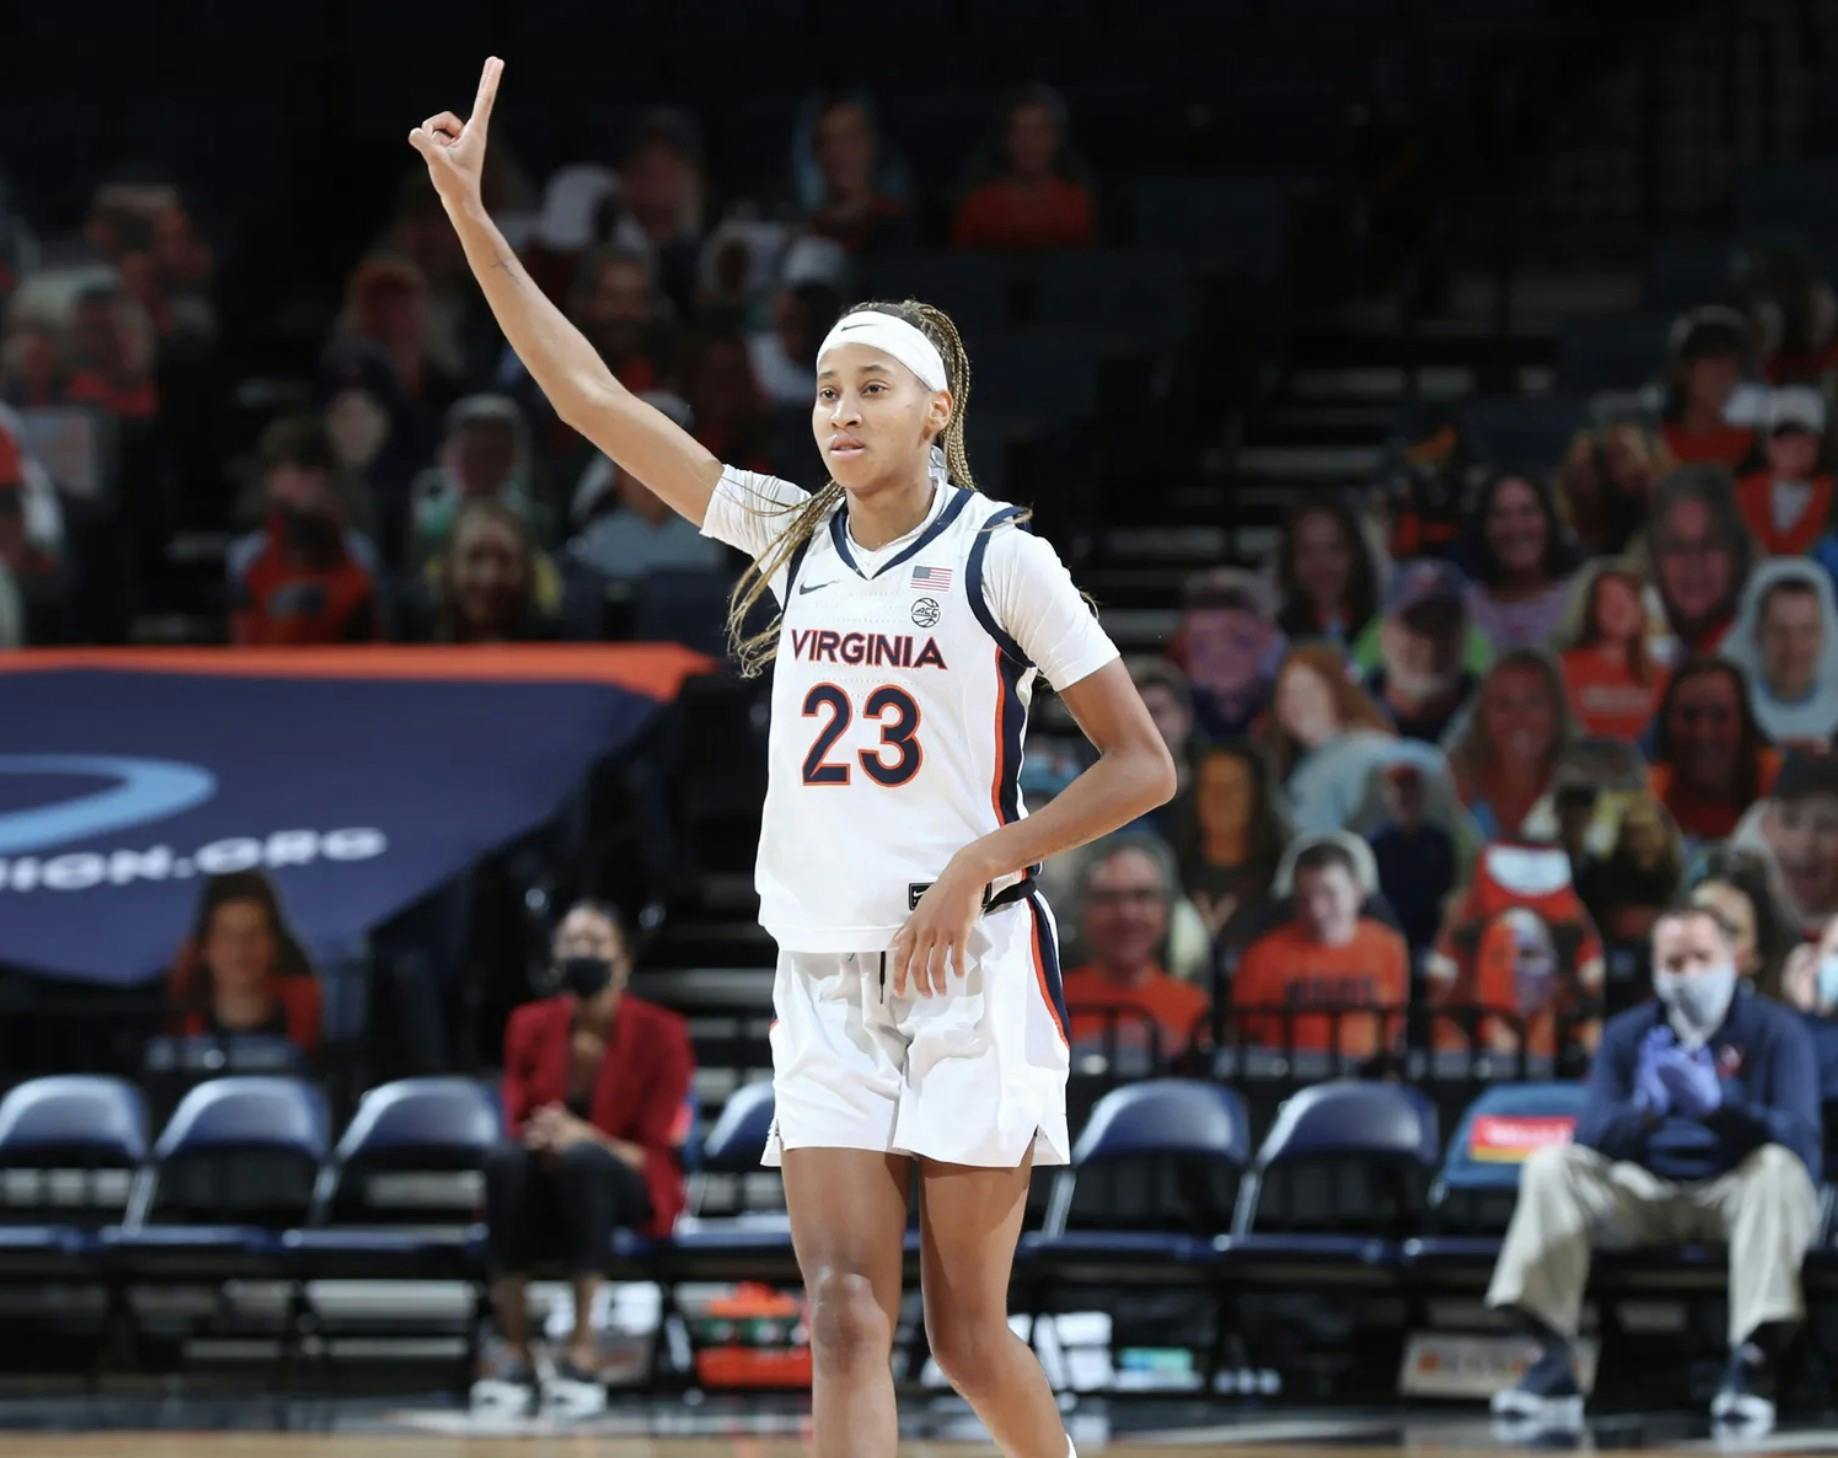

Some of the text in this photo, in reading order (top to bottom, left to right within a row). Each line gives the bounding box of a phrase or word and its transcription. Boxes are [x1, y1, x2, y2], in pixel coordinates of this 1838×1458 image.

[791, 629, 949, 670] VIRGINIA
[801, 682, 924, 788] 23
[0, 827, 388, 891] ION.ORG
